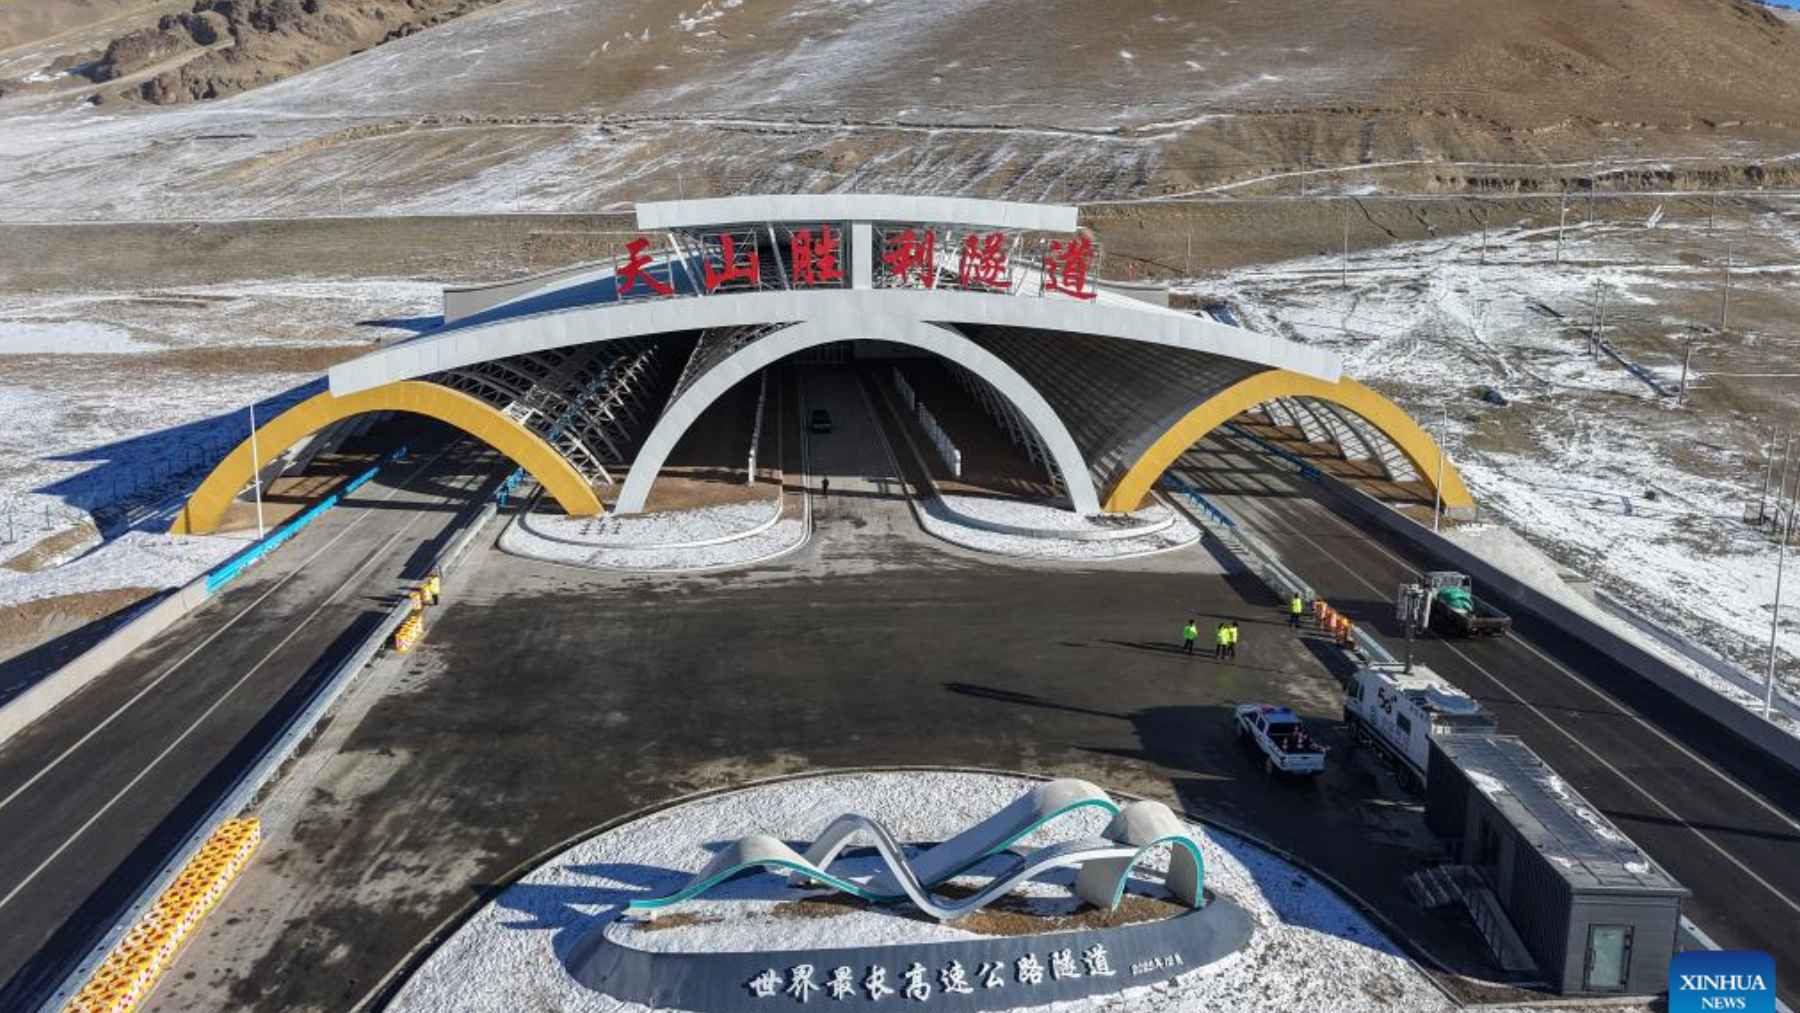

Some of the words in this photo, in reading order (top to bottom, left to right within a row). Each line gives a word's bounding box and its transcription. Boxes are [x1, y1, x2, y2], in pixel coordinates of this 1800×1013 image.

[616, 224, 1098, 299] 天山胜利隧道
[750, 943, 1116, 1003] 世界最长高速公路隧道
